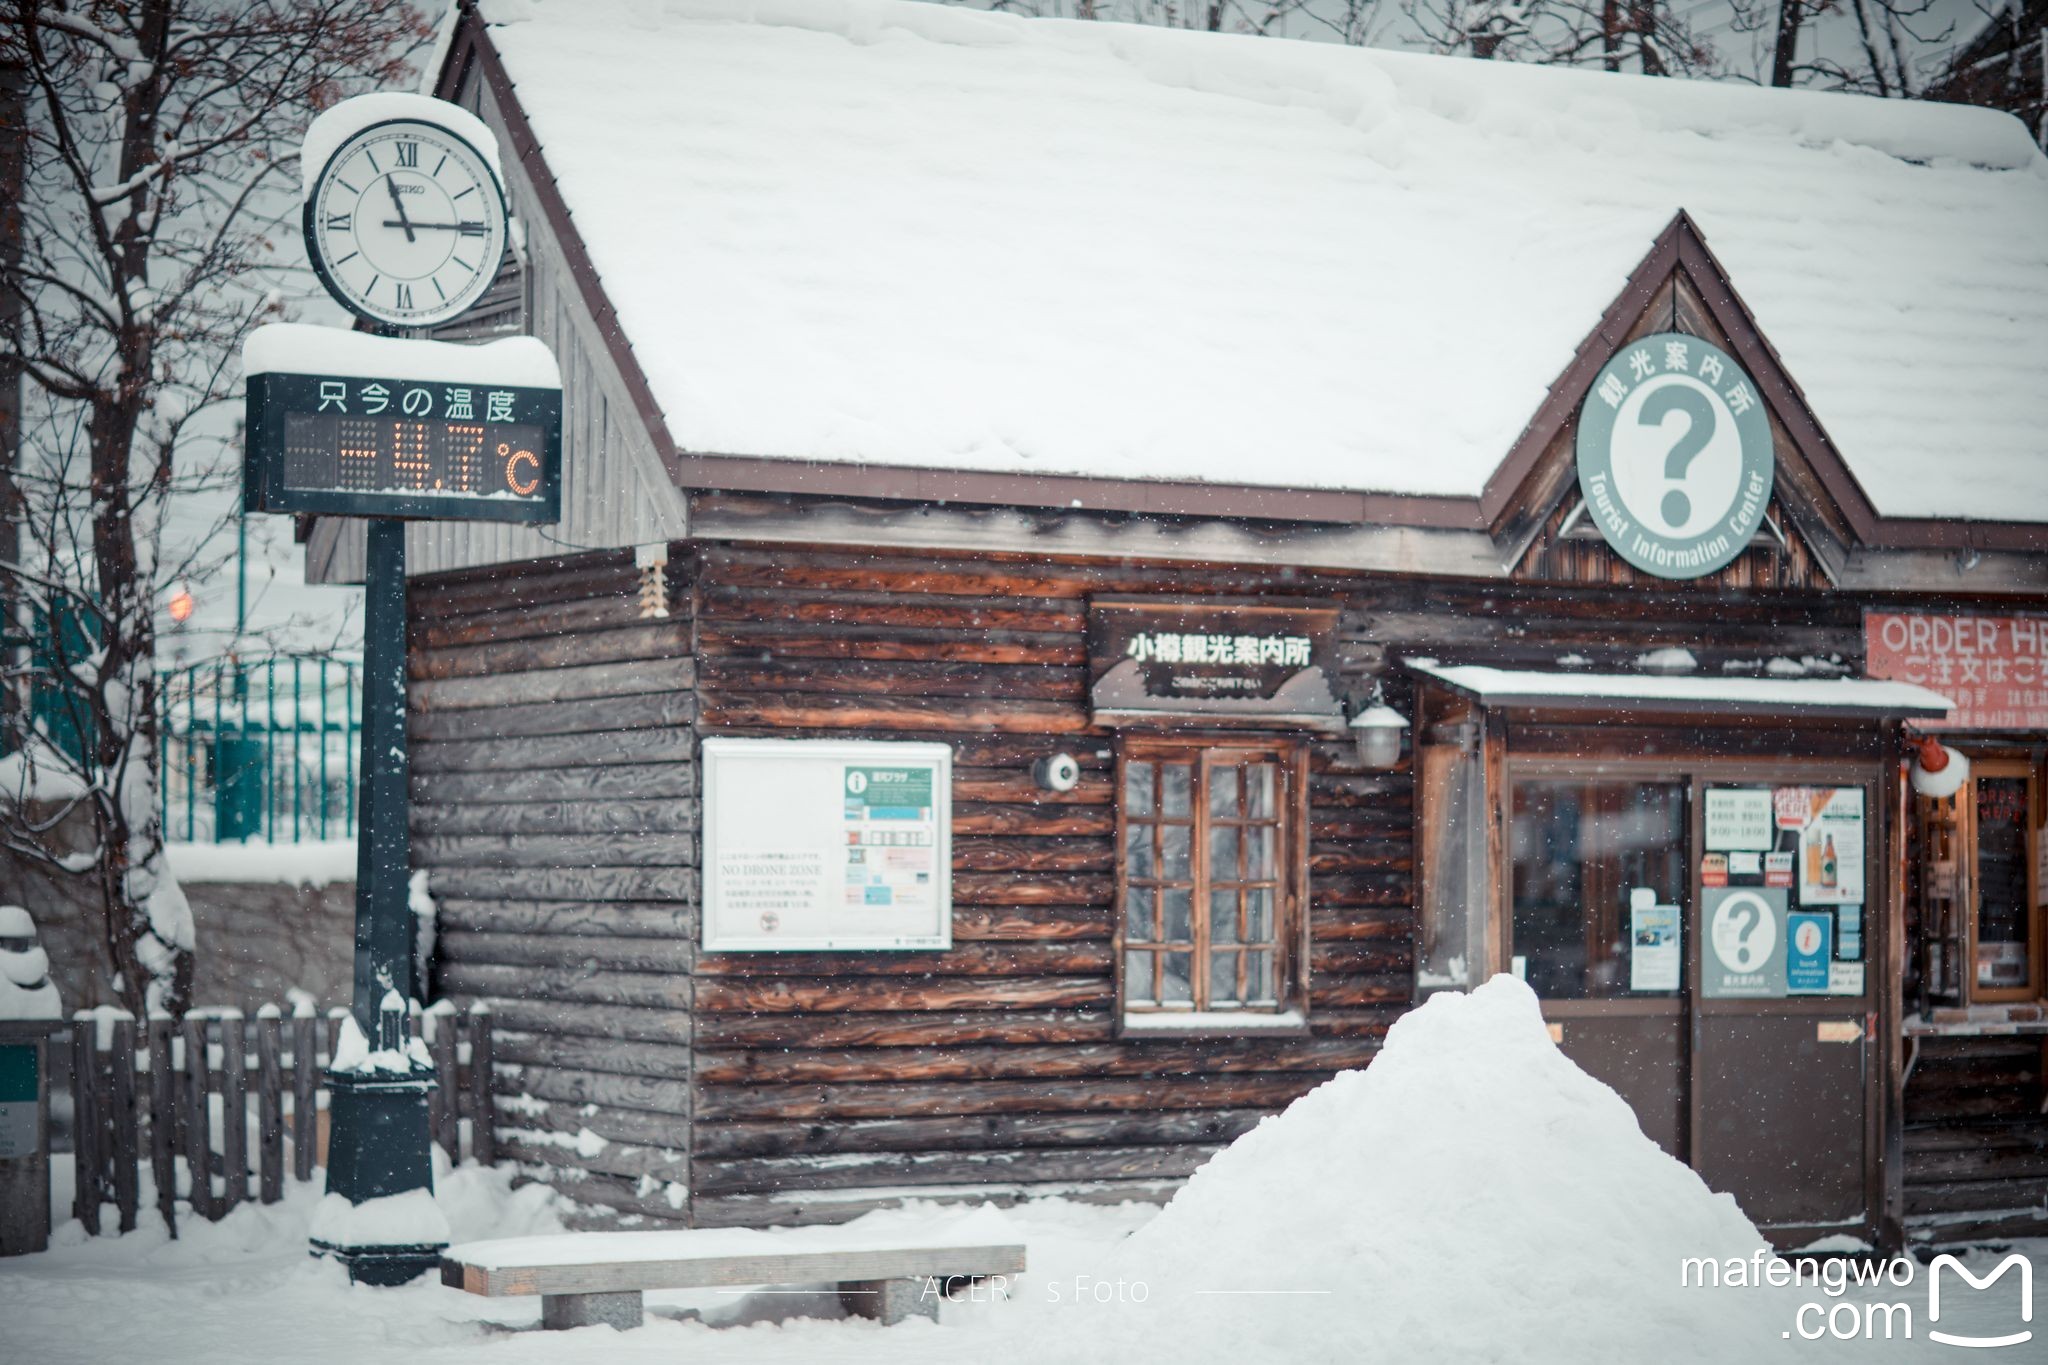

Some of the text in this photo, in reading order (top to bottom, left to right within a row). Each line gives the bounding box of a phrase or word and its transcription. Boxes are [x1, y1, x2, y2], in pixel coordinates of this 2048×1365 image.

[391, 184, 425, 195] EIKO
[1596, 340, 1755, 417] 観光案内所
[317, 381, 516, 423] 只今の温度
[1588, 470, 1765, 569] Tourist Information Center
[1127, 632, 1312, 667] 小樽観光案内所
[1881, 615, 1999, 655] ORDER
[721, 864, 823, 876] NO DRONE ZONE
